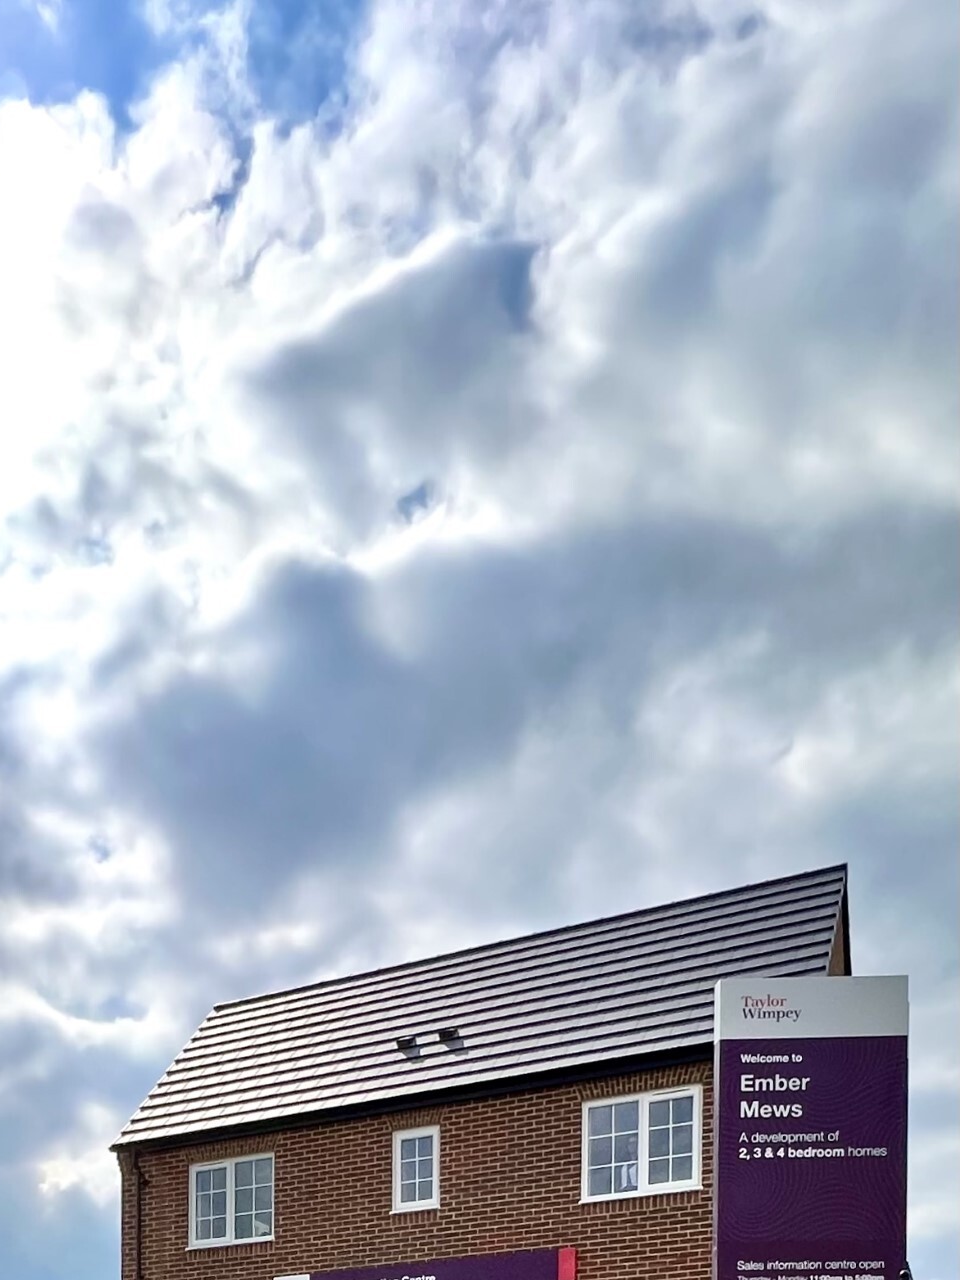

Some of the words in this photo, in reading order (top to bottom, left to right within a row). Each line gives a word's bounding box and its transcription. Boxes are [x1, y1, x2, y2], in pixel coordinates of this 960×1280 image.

[741, 994, 787, 1008] Taylor
[742, 1008, 802, 1022] Wimpey
[740, 1053, 790, 1063] Welcome
[791, 1053, 803, 1062] to
[740, 1074, 810, 1092] Ember
[740, 1101, 803, 1118] Mews
[739, 1132, 749, 1143] A
[751, 1131, 825, 1144] development
[827, 1130, 840, 1142] of
[739, 1147, 750, 1160] 2,
[753, 1147, 762, 1159] 3
[764, 1147, 774, 1158] &
[776, 1147, 785, 1158] 4
[787, 1146, 845, 1158] bedroom
[847, 1146, 888, 1157] homes
[737, 1260, 764, 1271] Sales
[766, 1259, 822, 1270] information
[824, 1260, 857, 1270] centre
[858, 1260, 885, 1271] open
